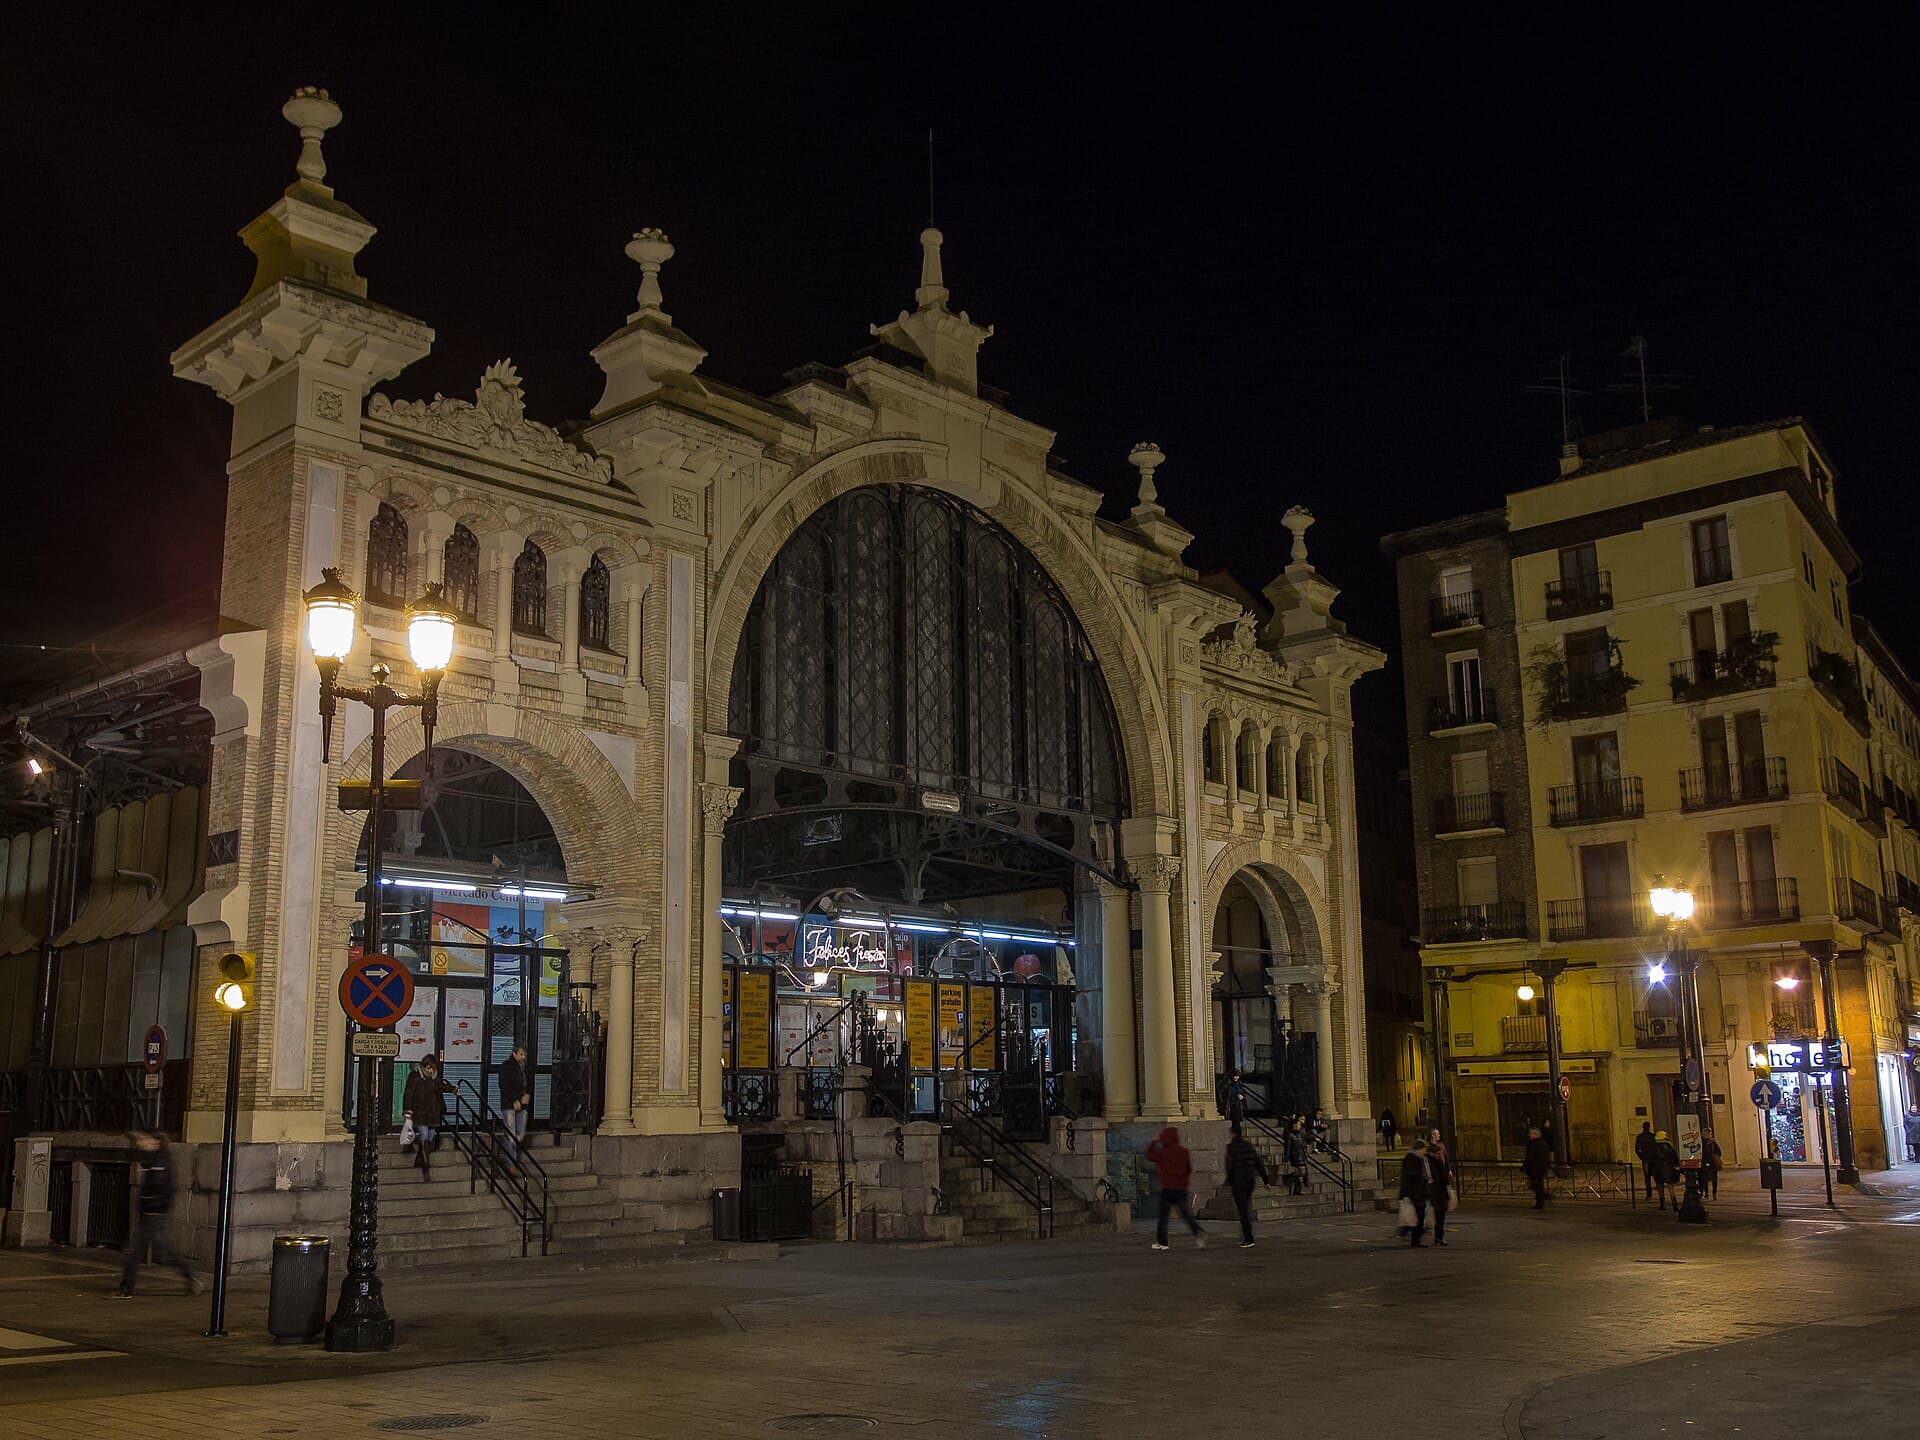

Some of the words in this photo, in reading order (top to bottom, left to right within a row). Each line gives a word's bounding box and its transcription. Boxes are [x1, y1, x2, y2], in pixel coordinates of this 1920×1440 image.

[804, 928, 850, 967] Felices
[847, 930, 887, 971] Fiestas
[940, 988, 962, 999] parking
[940, 998, 962, 1007] gratuito
